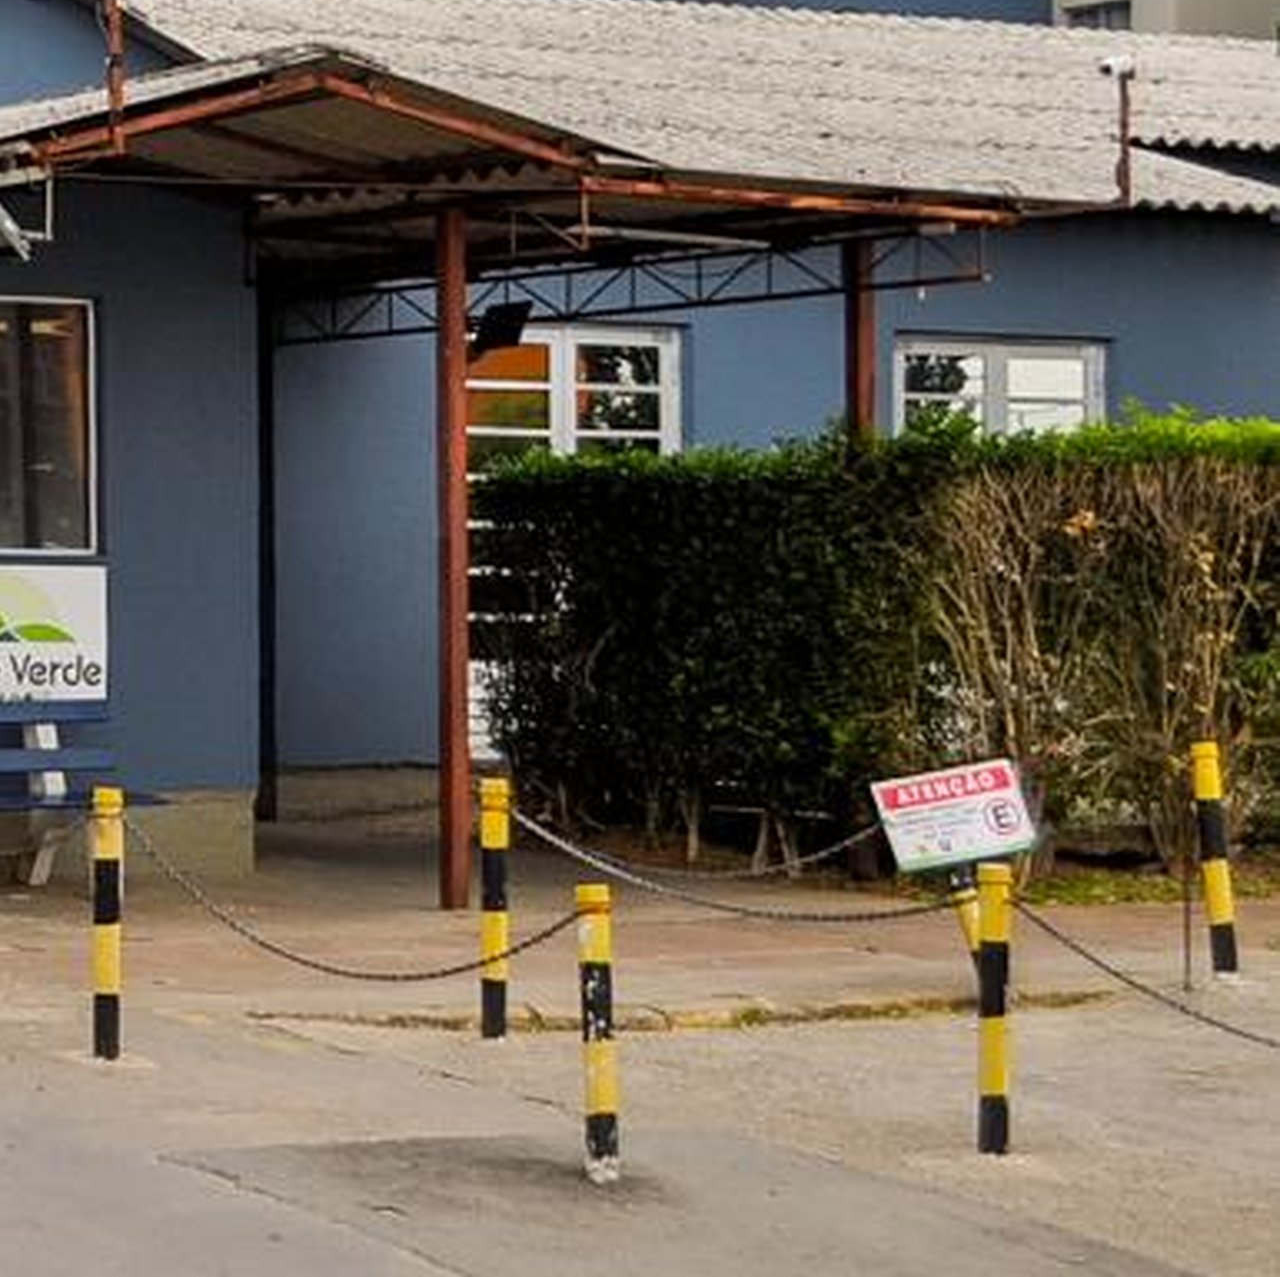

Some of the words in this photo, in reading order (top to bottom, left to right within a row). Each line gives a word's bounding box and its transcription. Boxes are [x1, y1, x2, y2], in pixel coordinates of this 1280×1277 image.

[9, 654, 102, 686] Verde
[896, 770, 997, 805] ATENÇÃO
[992, 804, 1010, 828] E
